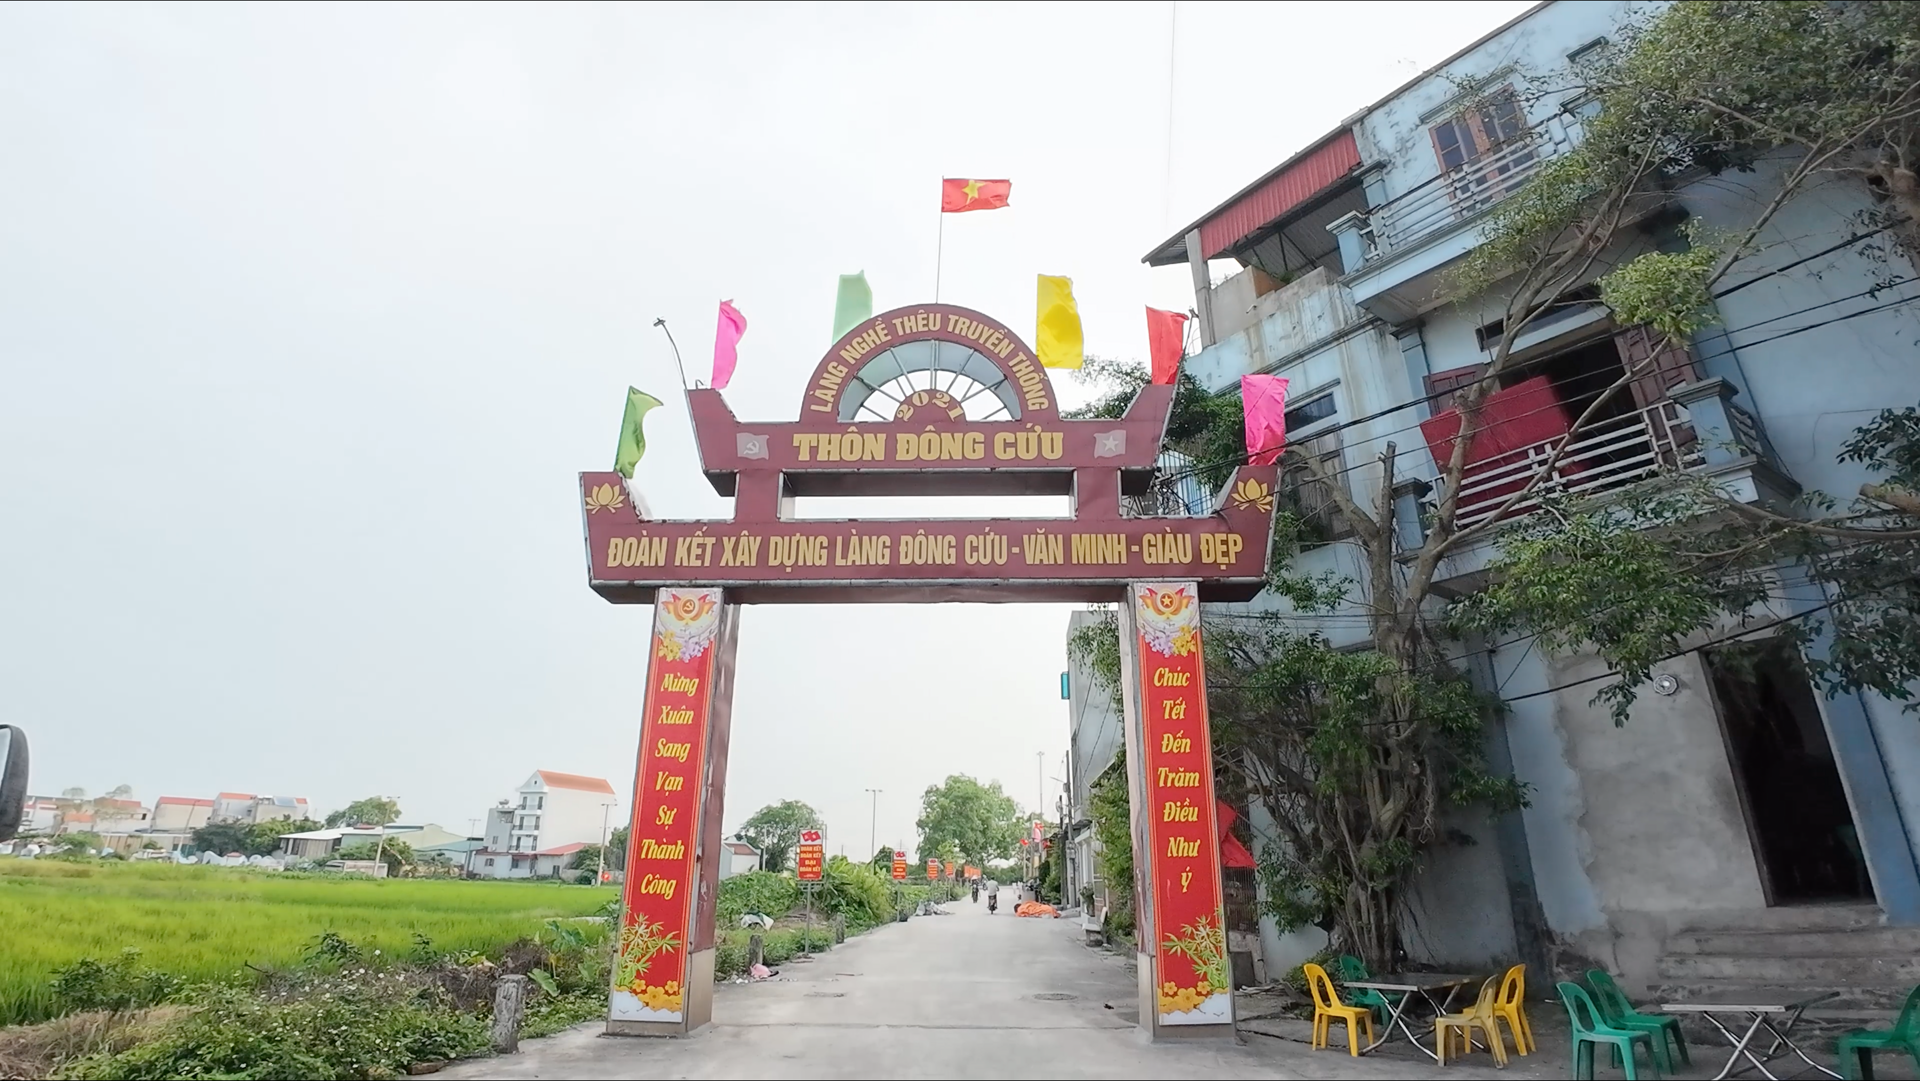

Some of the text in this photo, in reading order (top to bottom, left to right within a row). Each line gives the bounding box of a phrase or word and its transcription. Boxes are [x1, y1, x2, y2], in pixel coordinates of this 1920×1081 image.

[810, 310, 1048, 412] LÀNG NGHỀ THÊU TRUYỀN THỐNG
[896, 391, 964, 421] 2021
[793, 423, 1064, 461] THÔN ĐÔNG CỨU
[607, 530, 667, 567] ĐOÀN
[674, 527, 716, 567] KẾT
[719, 530, 762, 567] XÂY
[768, 532, 828, 573] DỰNG
[835, 528, 891, 565] LÀNG
[899, 528, 956, 565] ĐÔNG
[964, 527, 1008, 565] CỨU
[1022, 527, 1063, 565] VĂN
[1071, 533, 1127, 564] MINH
[1142, 526, 1192, 564] GIÀU
[1200, 532, 1243, 570] ĐẸP
[660, 673, 699, 697] Mừng
[1153, 666, 1190, 687] Chúc
[658, 705, 694, 725] Xuân
[1162, 697, 1187, 720] Tết
[655, 738, 690, 762] Sang
[1161, 730, 1191, 753] Đến
[655, 771, 684, 796] Vạn
[1157, 767, 1200, 787] Trăm
[656, 805, 677, 830] Sự
[1163, 798, 1198, 822] Điều
[641, 838, 685, 860] Thành
[1167, 836, 1201, 858] Như
[641, 874, 677, 899] Công
